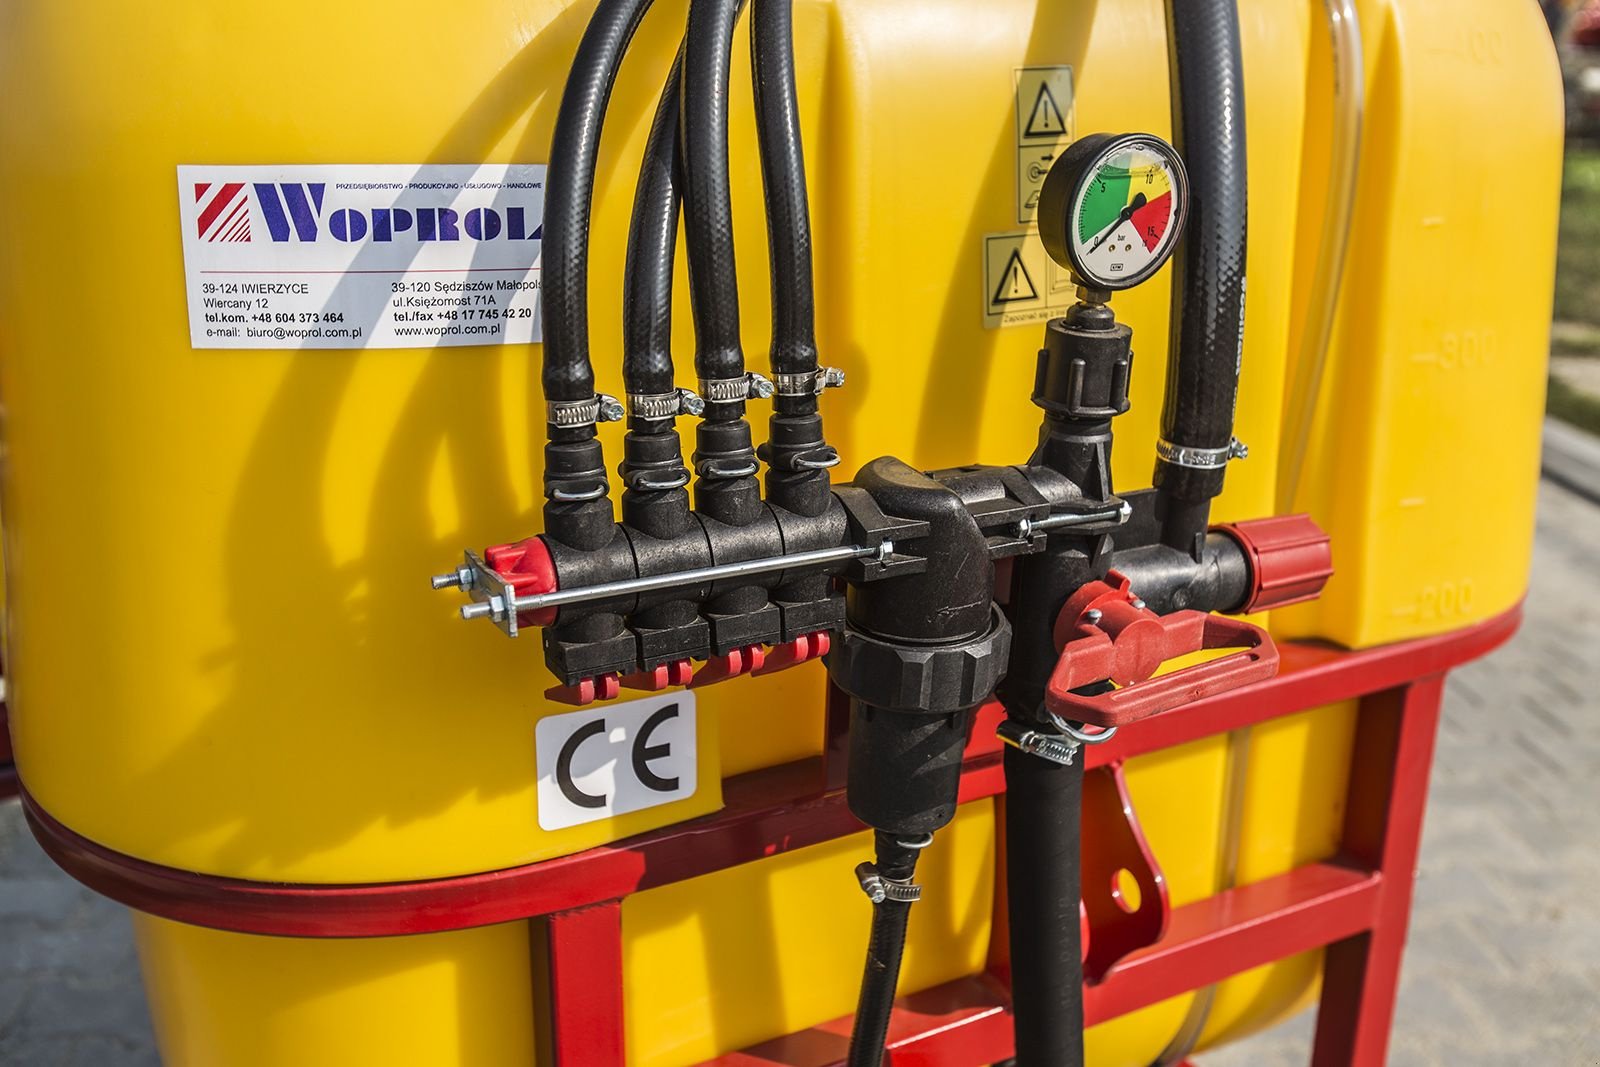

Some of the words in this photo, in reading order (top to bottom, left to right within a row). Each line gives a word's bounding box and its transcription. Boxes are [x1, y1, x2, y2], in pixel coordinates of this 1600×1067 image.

[1145, 174, 1154, 185] 10
[335, 182, 404, 191] PRZEDSIĘBIORSTWO
[408, 182, 459, 190] PRODUKCYJNO
[1100, 182, 1106, 193] 5
[1147, 226, 1156, 237] 15
[1117, 234, 1126, 242] bar
[202, 283, 238, 294] 39-124
[241, 283, 309, 294] IWIERZYCE
[391, 282, 431, 293] 39-120
[434, 280, 493, 294] Sędziszów
[203, 298, 252, 310] Wiercany
[256, 298, 269, 309] 12
[392, 296, 471, 309] ul.Księżomost
[474, 295, 497, 306] 71A
[205, 312, 249, 323] tel.kom.
[251, 312, 272, 323] +48
[275, 312, 296, 323] 604
[299, 312, 320, 323] 373
[322, 312, 344, 323] 464
[393, 311, 434, 322] tel./fax
[436, 310, 458, 321] +48
[461, 310, 475, 320] 17
[478, 309, 499, 320] 745
[501, 308, 516, 319] 42
[518, 308, 532, 318] 20
[206, 327, 241, 338] e-mail:
[246, 326, 363, 340] biuro@woprol.com.pl
[394, 323, 501, 337] www.woprol.com.pl
[556, 703, 679, 809] CE
